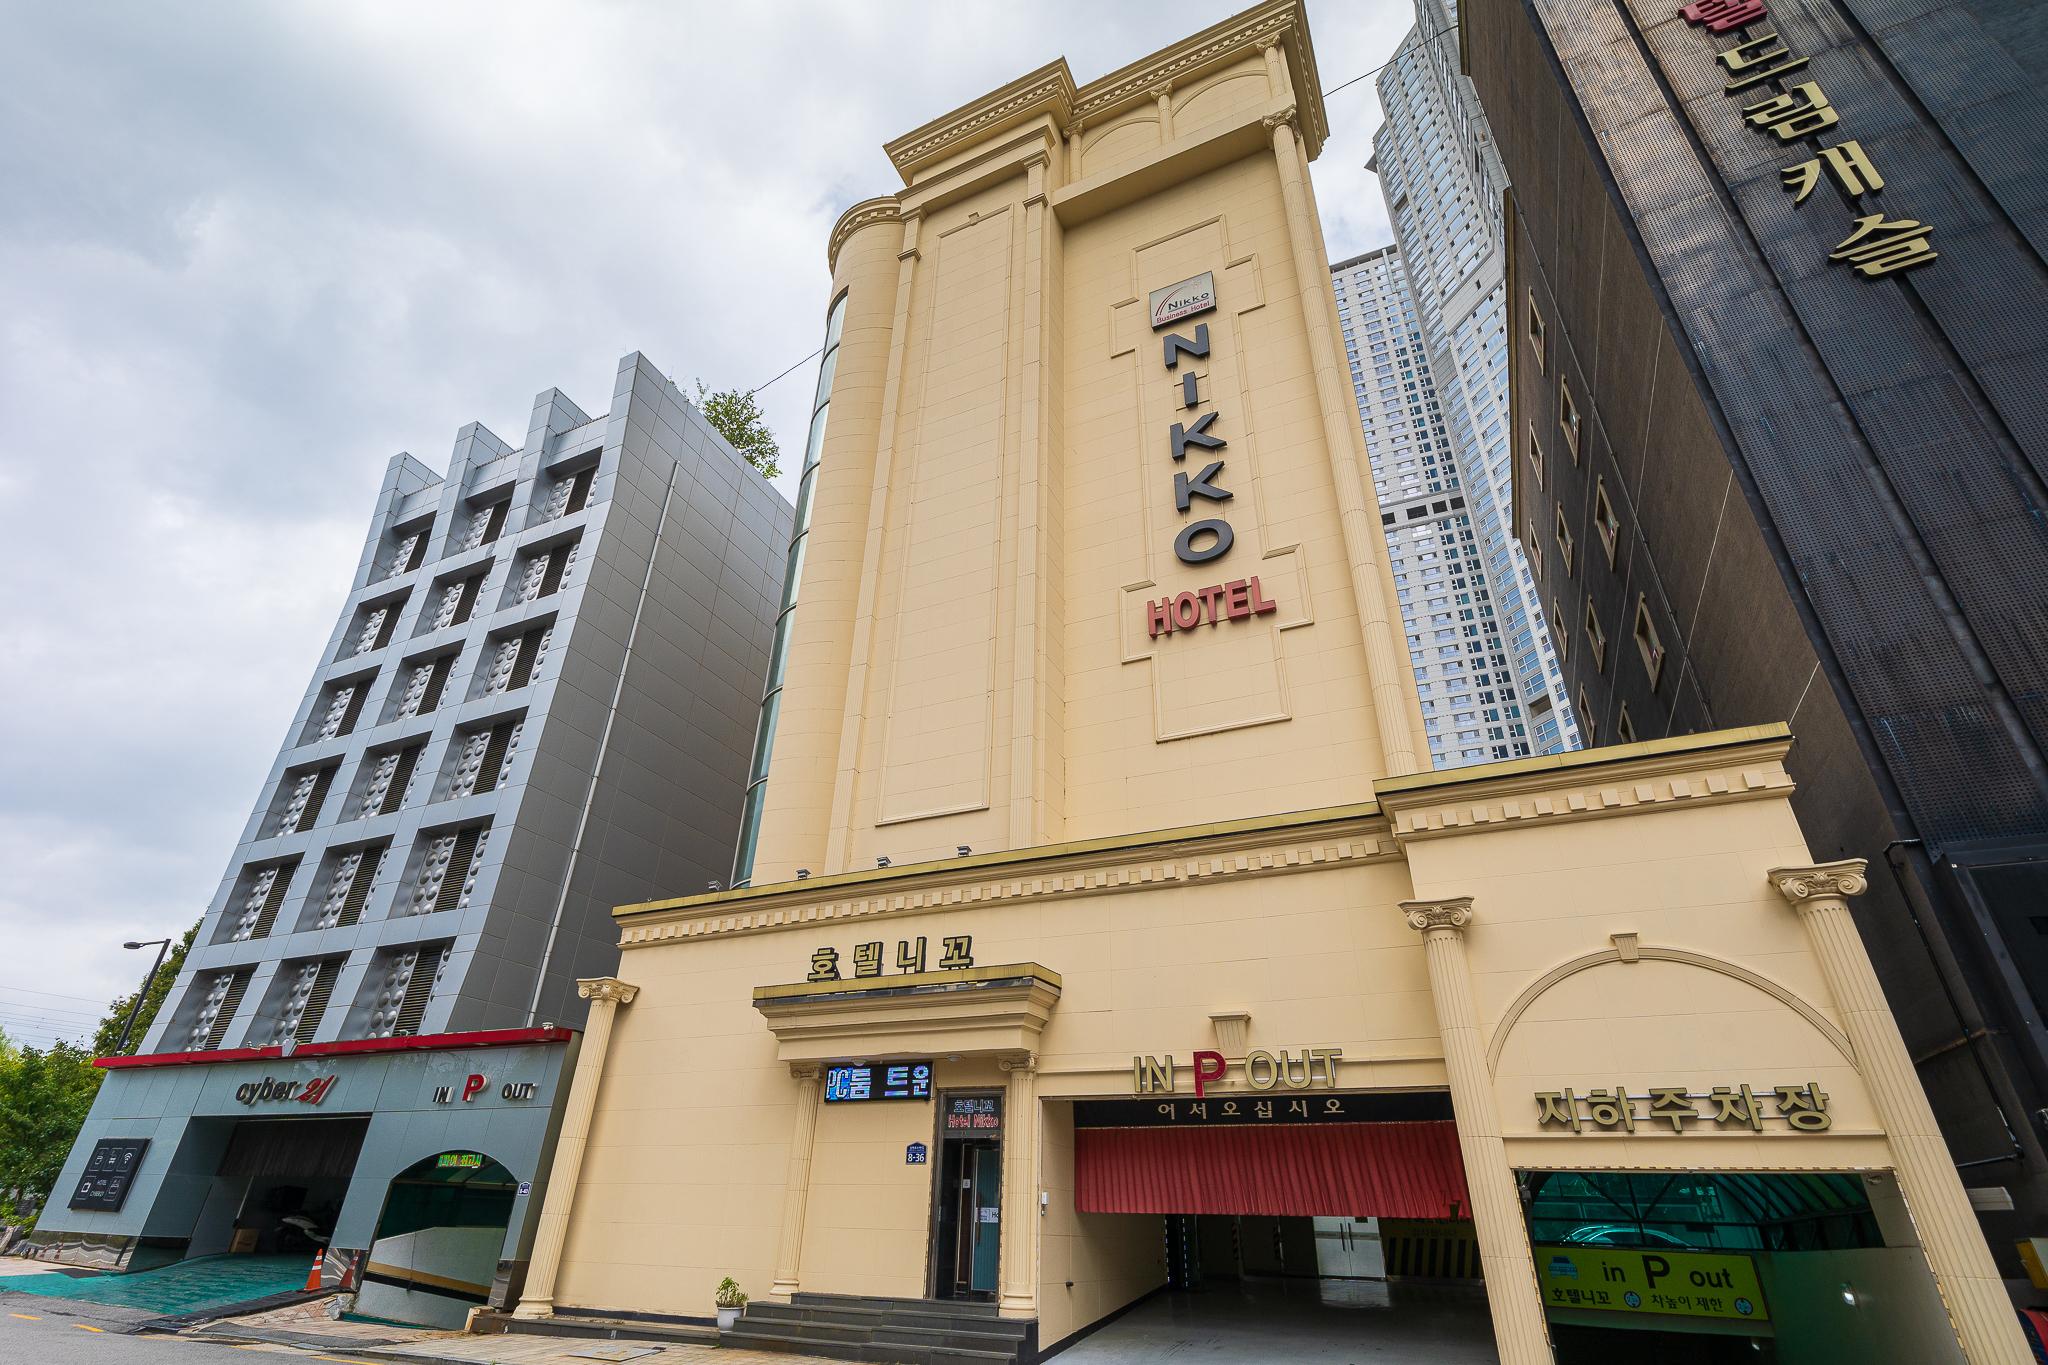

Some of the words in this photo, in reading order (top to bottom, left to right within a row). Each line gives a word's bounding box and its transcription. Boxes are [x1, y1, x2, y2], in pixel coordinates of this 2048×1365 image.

[1156, 309, 1188, 324] Business
[1190, 300, 1210, 312] Hotel
[1163, 323, 1234, 565] NIKKO
[1147, 576, 1276, 638] HOTEL
[807, 935, 974, 982] 호텔니꼬
[432, 1086, 454, 1103] IN
[462, 1074, 490, 1102] P
[501, 1082, 536, 1100] OUT
[826, 1067, 872, 1099] PC룸
[1133, 1055, 1174, 1093] IN
[1193, 1050, 1228, 1099] P
[1244, 1048, 1343, 1090] OUT
[947, 1113, 971, 1128] Hotel
[973, 1113, 999, 1128] Nikko
[953, 1099, 995, 1114] 호텔니꼬
[1157, 1099, 1346, 1120] 어서오십시오
[1534, 1082, 1832, 1133] 지하주차장
[907, 1153, 925, 1162] 8-36
[1602, 1262, 1626, 1283] in
[1642, 1255, 1670, 1289] P
[1689, 1268, 1734, 1289] out
[1552, 1288, 1612, 1306] 호텔니꼬
